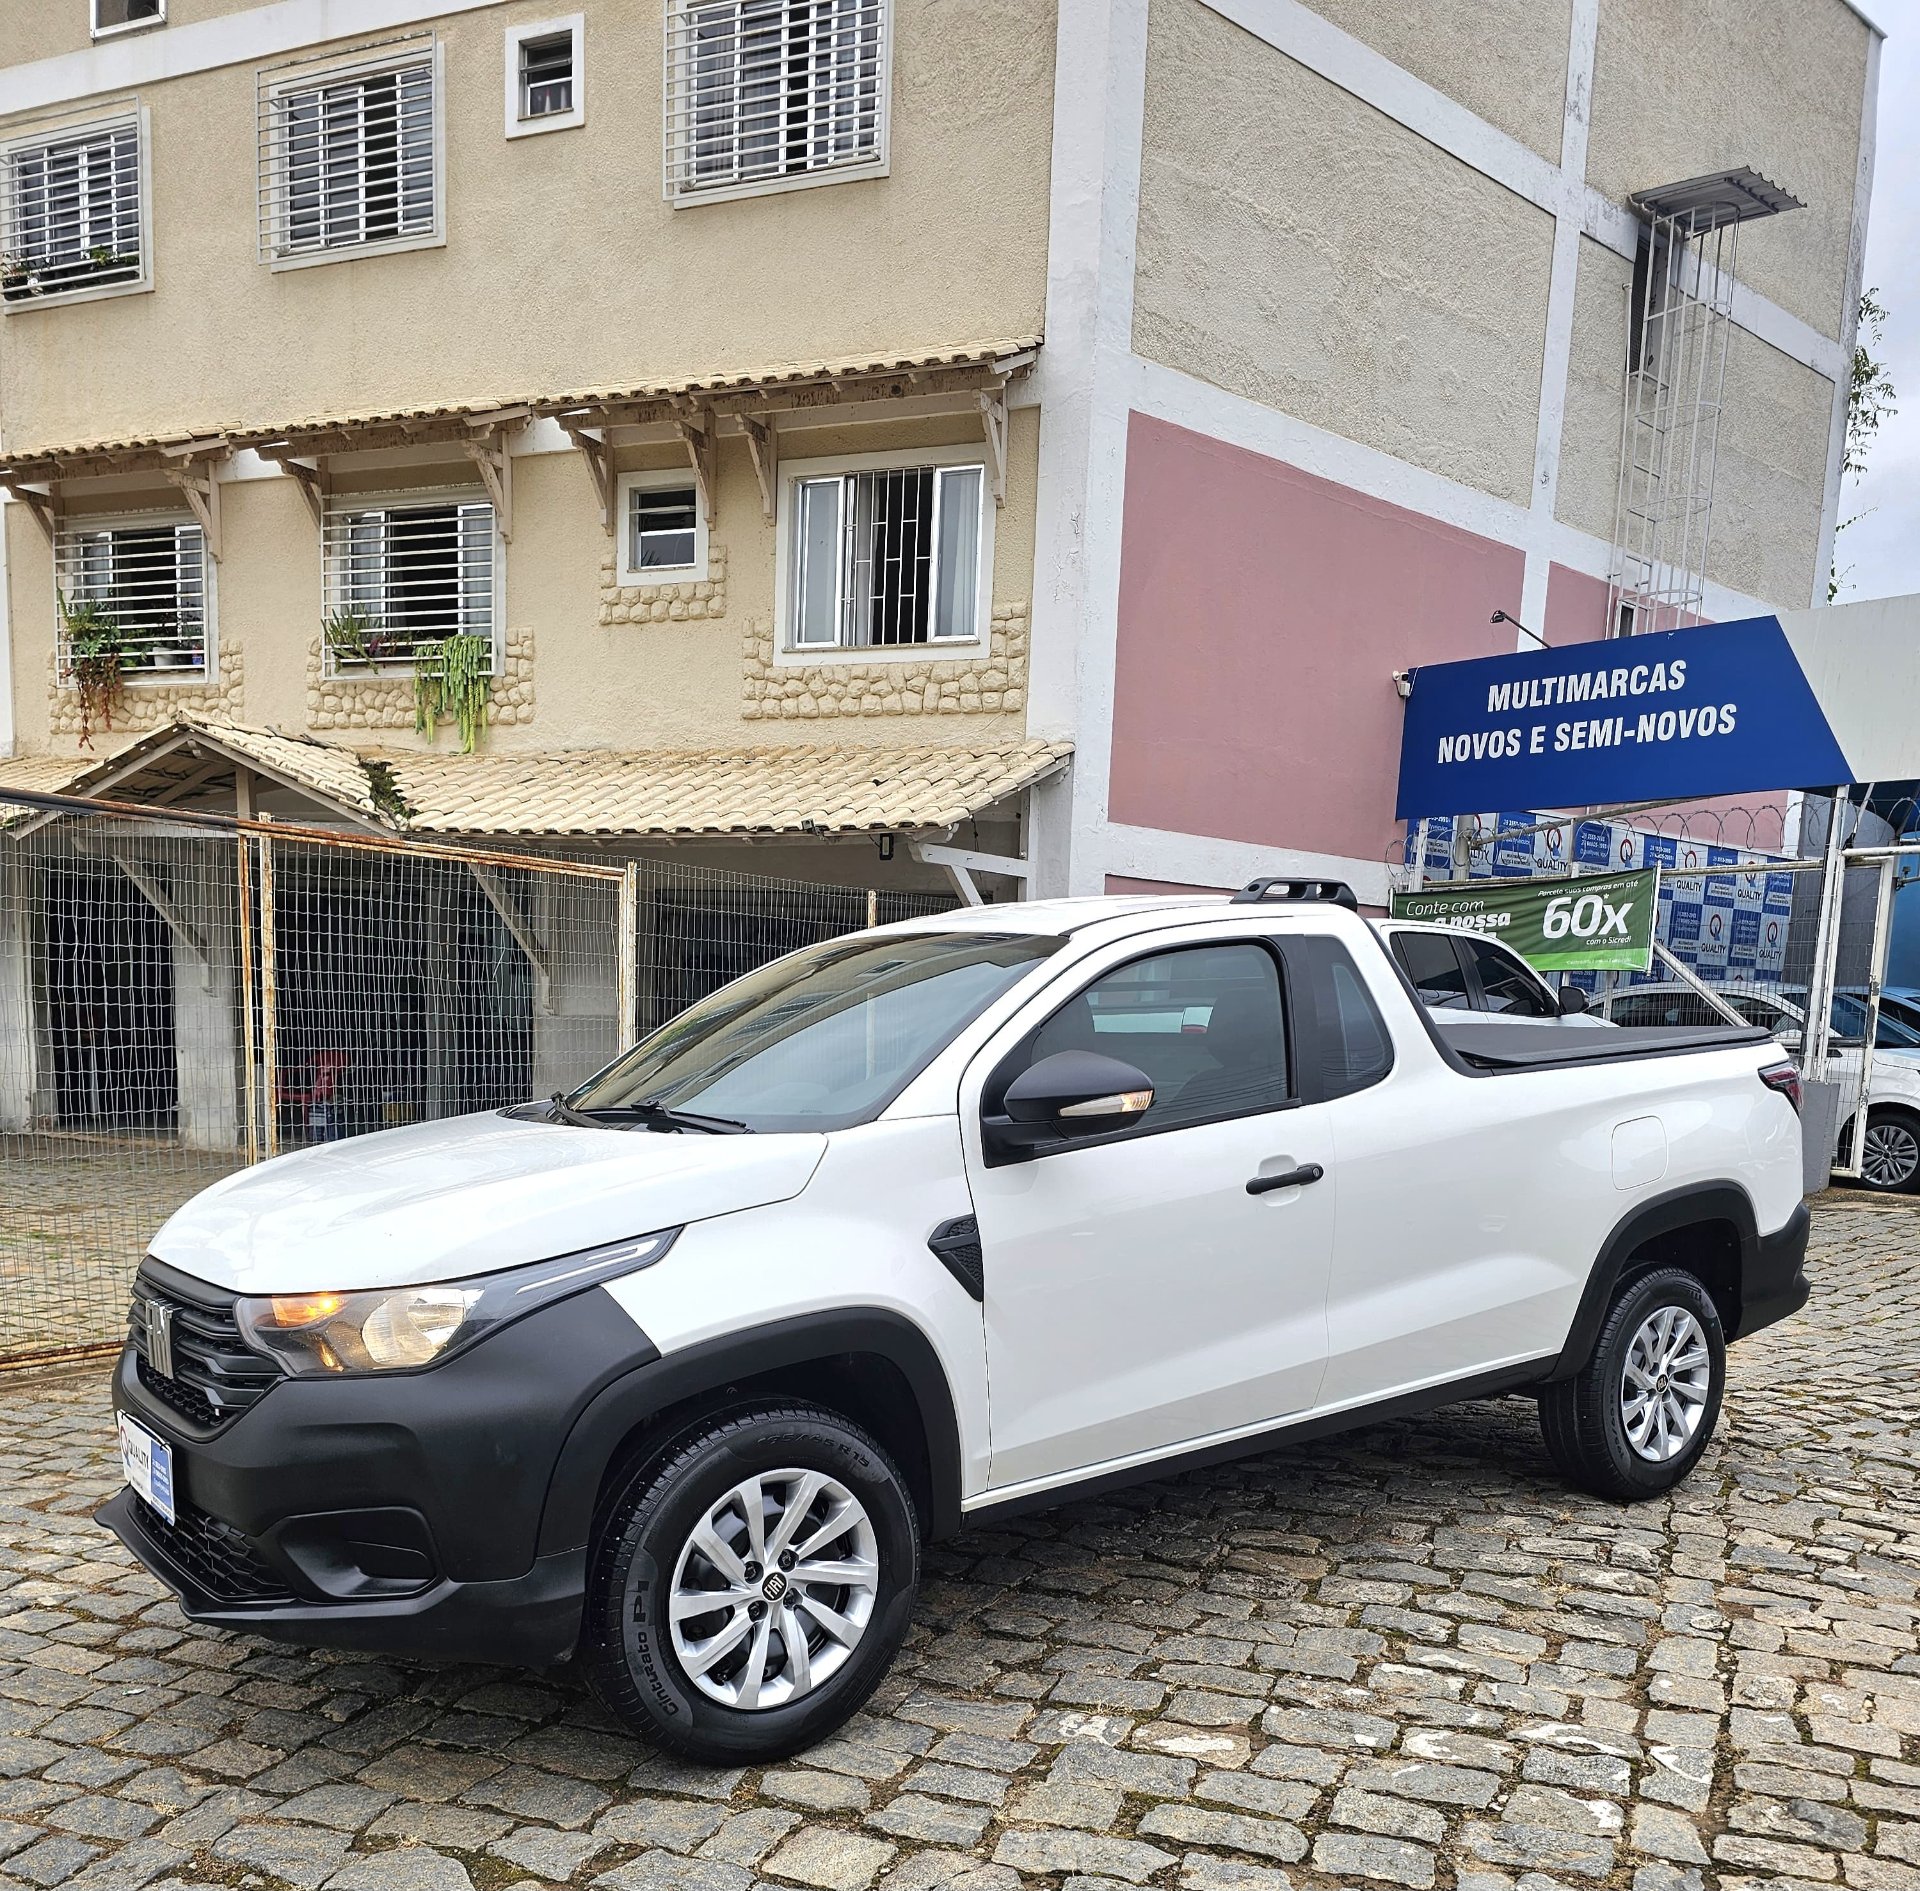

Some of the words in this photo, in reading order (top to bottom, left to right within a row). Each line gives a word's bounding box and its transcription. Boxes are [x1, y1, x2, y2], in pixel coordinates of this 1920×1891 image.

[1487, 659, 1687, 713] MULTIMARCAS
[1437, 730, 1521, 764] NOVOS
[1530, 725, 1547, 754] E
[1554, 703, 1738, 752] SEMI-NOVOS
[1537, 858, 1568, 872] QUALITY
[1582, 883, 1612, 893] compras
[1676, 880, 1703, 892] QUALITY
[1737, 888, 1762, 901] QUALITY
[1406, 901, 1449, 916] Conte
[1451, 900, 1485, 912] com
[1449, 912, 1512, 929] nossa
[1586, 938, 1601, 946] com
[1608, 935, 1632, 945] Sicredi
[1701, 942, 1726, 955] QUALITY
[1760, 948, 1783, 960] QUALITY
[128, 1439, 149, 1470] QUALITY
[764, 1574, 785, 1599] FIAT
